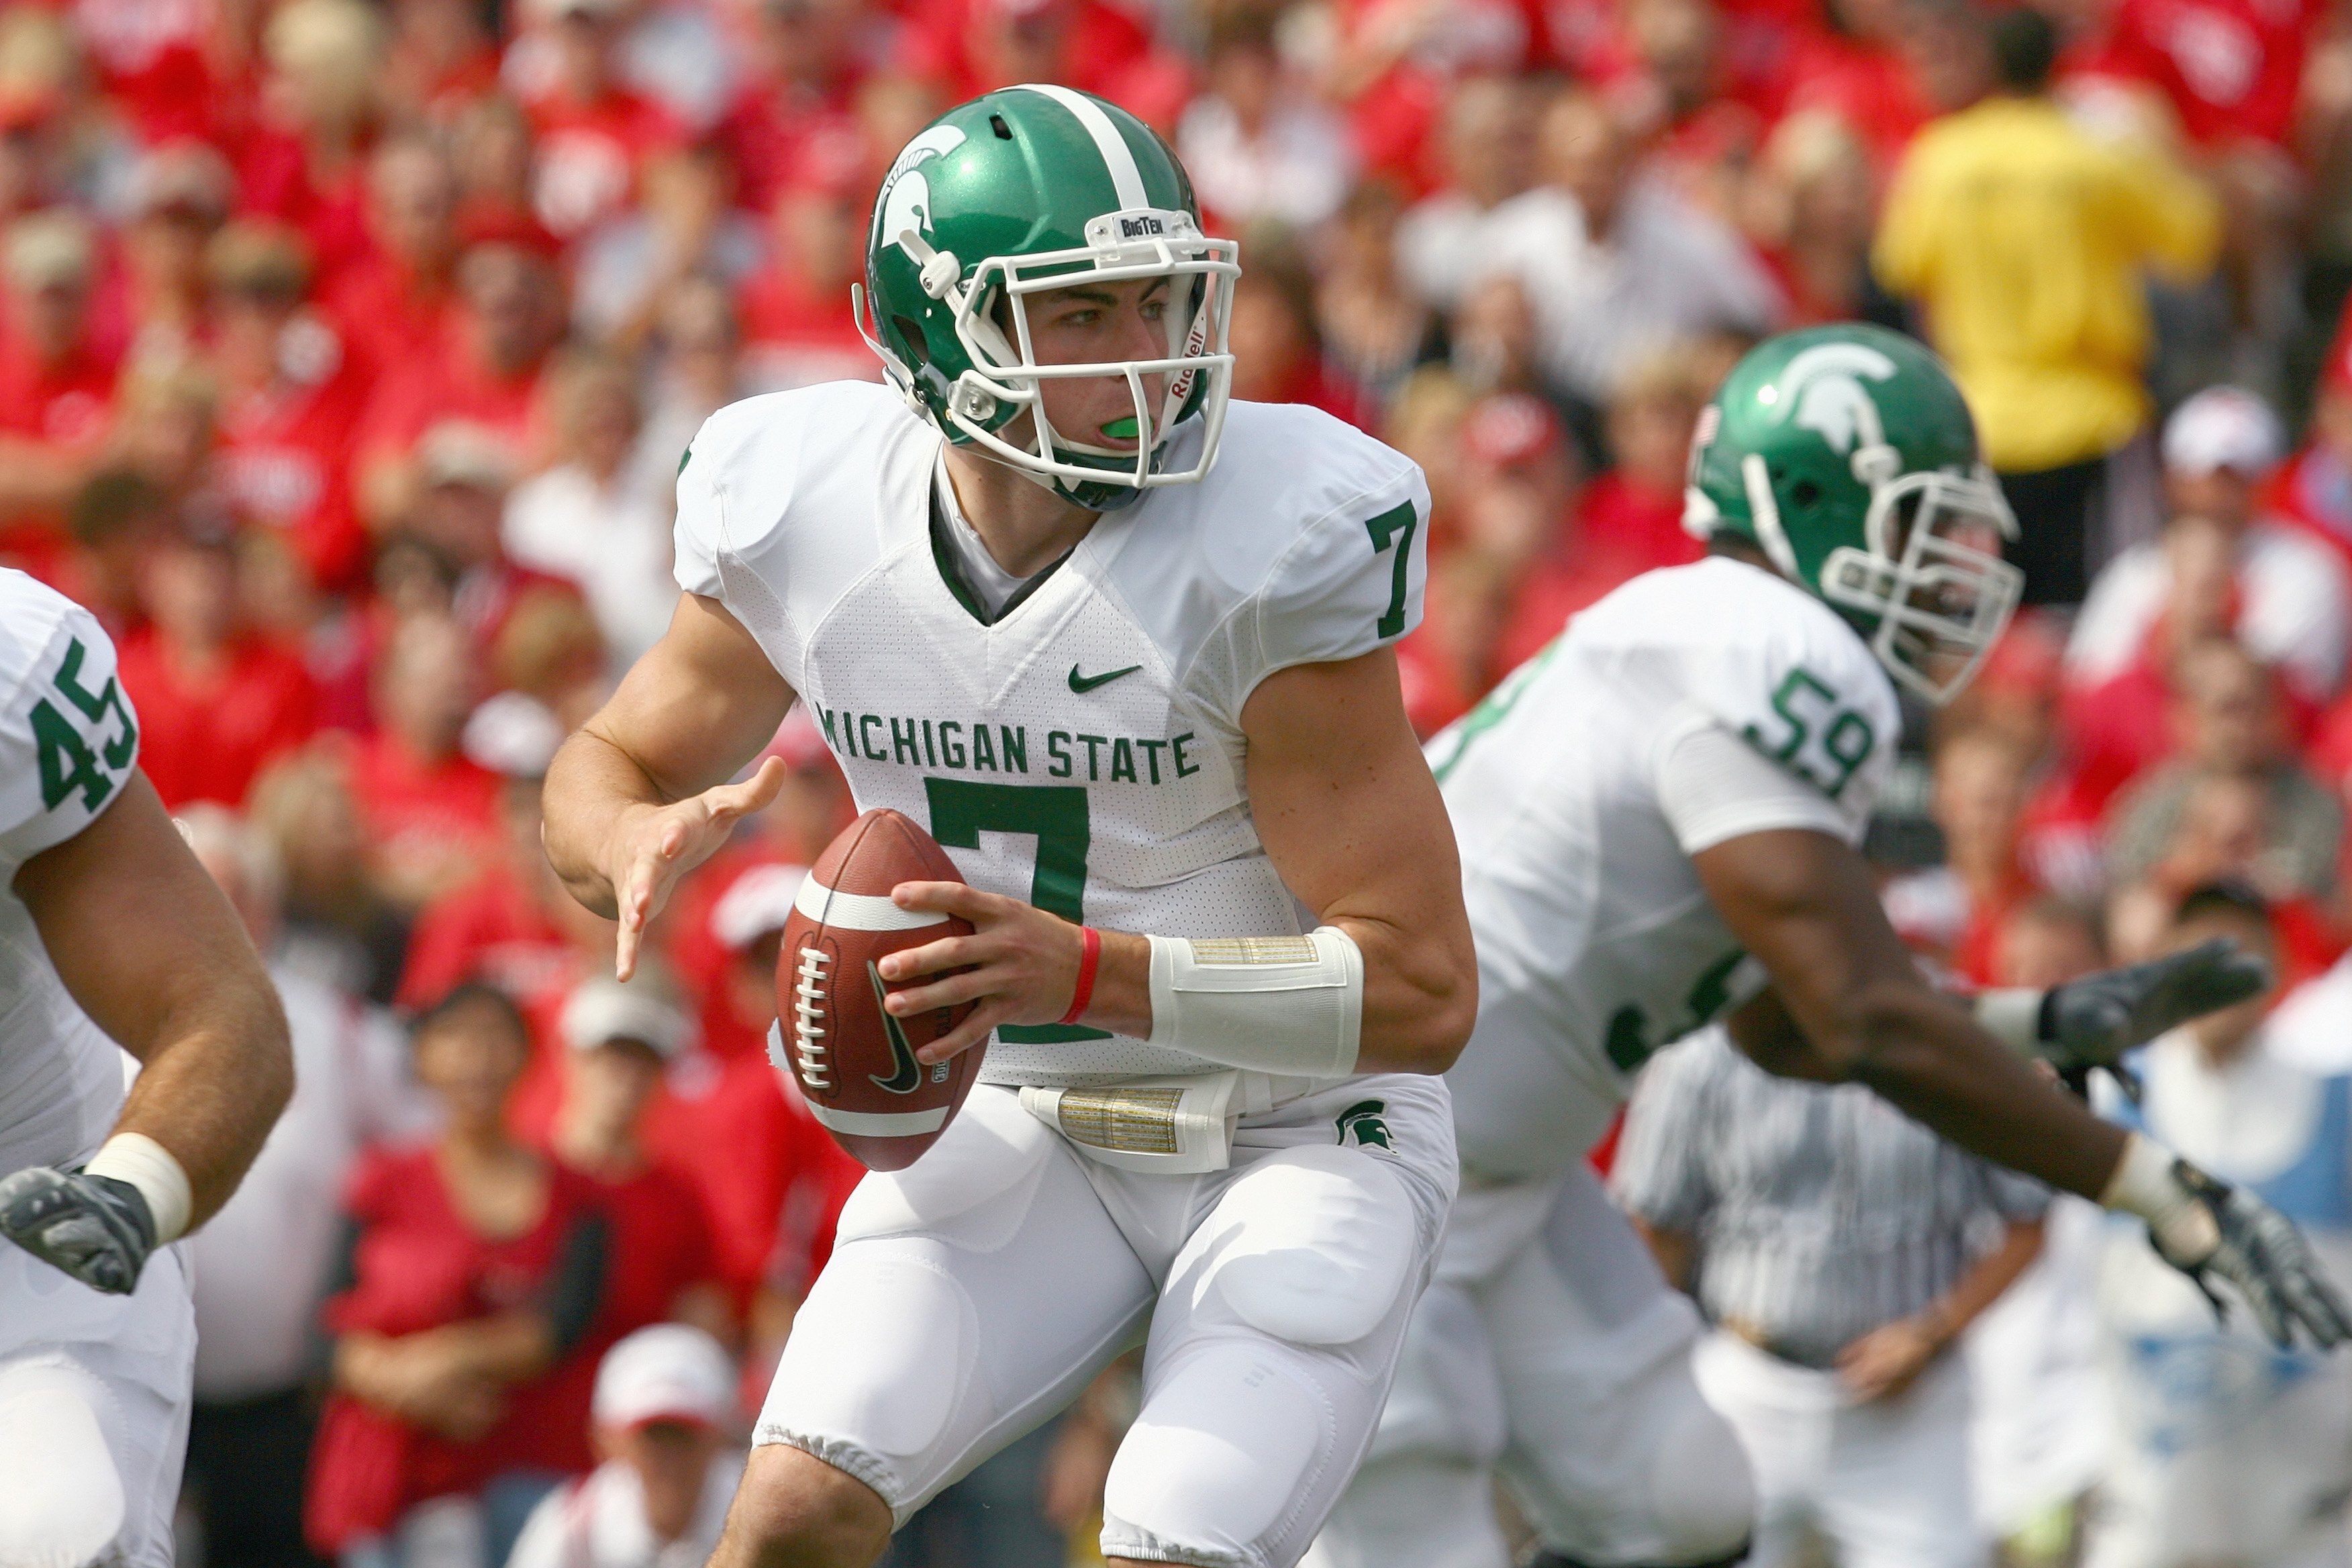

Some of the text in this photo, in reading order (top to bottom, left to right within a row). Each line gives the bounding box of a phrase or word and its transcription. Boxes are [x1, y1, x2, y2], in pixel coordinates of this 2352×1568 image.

[1365, 498, 1418, 639] 7
[29, 635, 137, 814] 45
[815, 701, 1200, 785] MICHIGAN STATE
[1743, 667, 1875, 800] 59
[923, 776, 1115, 1044] 7
